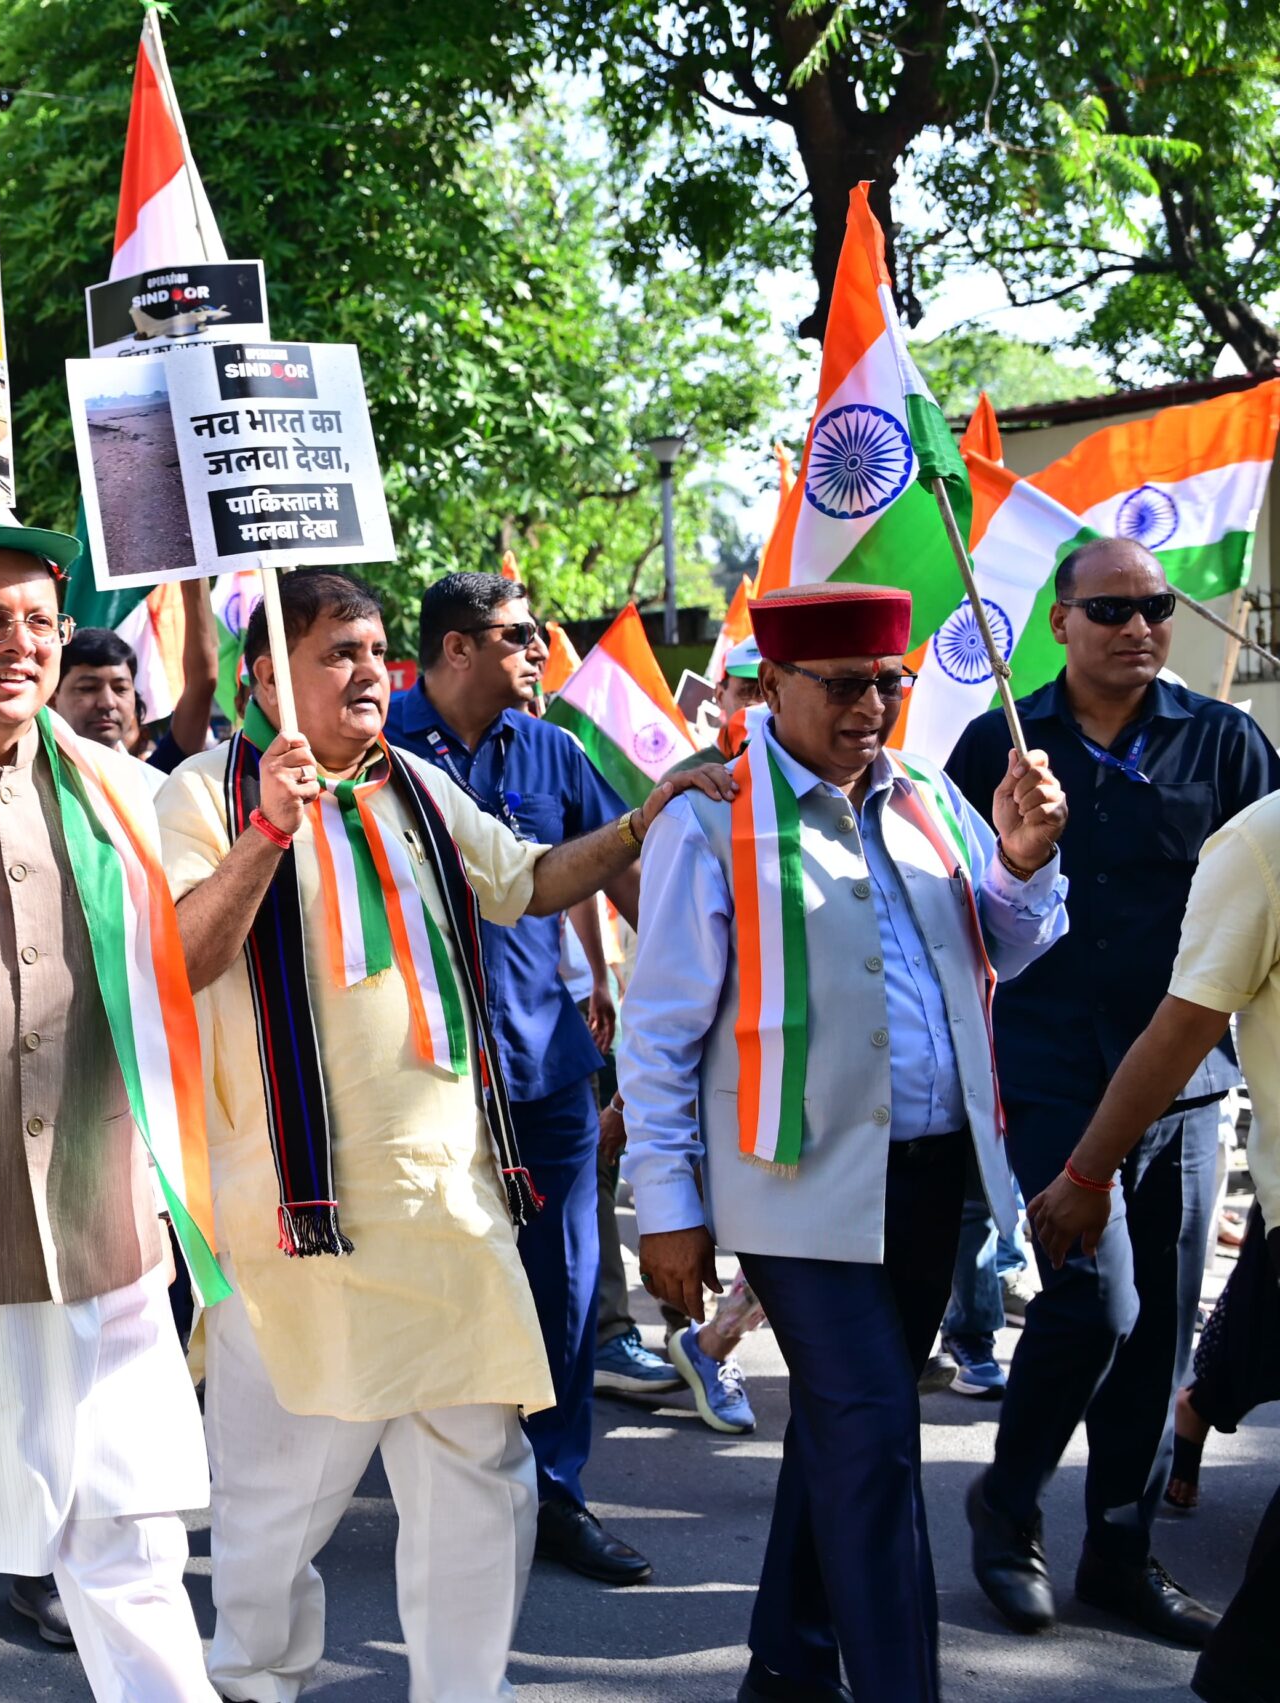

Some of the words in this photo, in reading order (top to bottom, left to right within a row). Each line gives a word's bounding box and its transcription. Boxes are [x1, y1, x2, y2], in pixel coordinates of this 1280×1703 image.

[190, 410, 240, 438] नव
[245, 409, 306, 433] भारत
[308, 410, 343, 433] का
[203, 446, 289, 475] जलवा
[292, 437, 350, 474] देखा,
[226, 488, 323, 515] पाकिस्तान
[323, 486, 340, 511] में
[238, 519, 299, 542] मलबा
[299, 514, 338, 540] देखा
